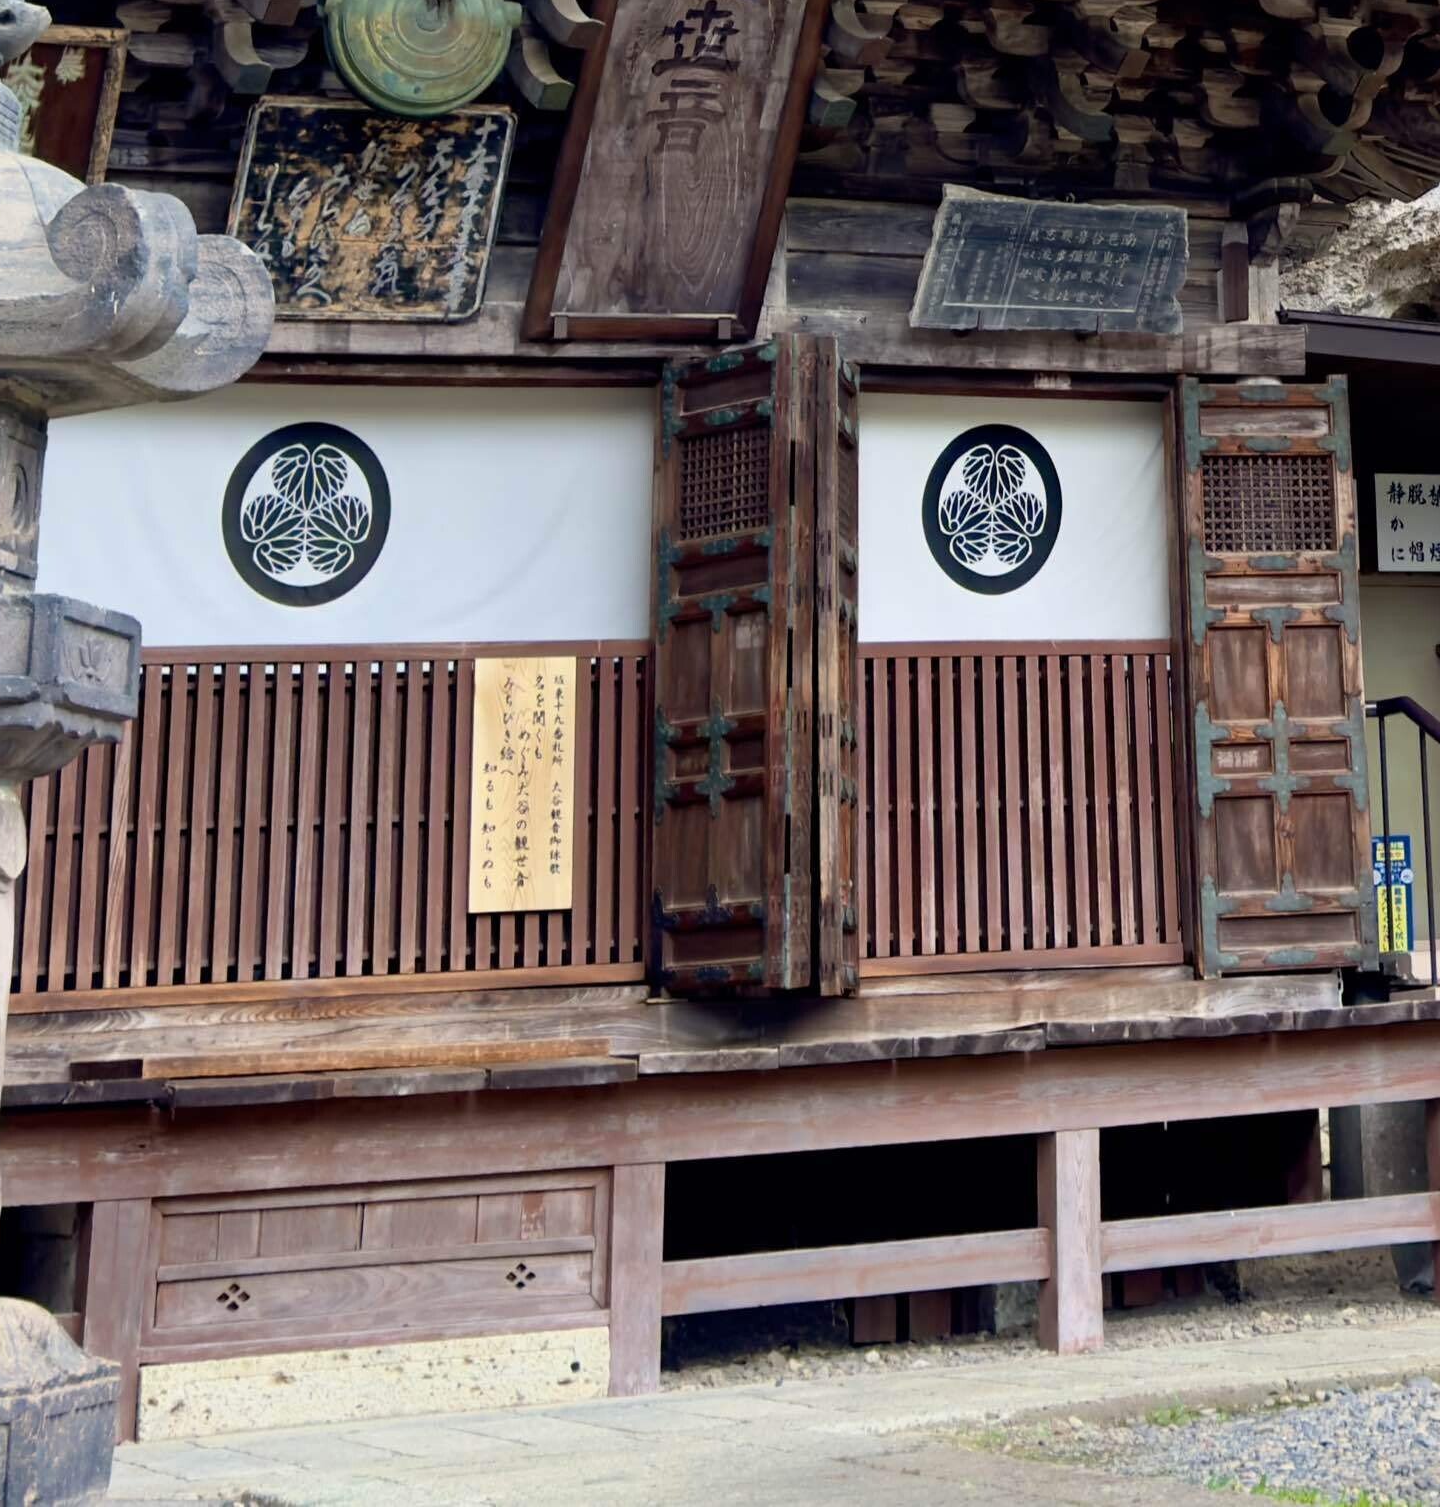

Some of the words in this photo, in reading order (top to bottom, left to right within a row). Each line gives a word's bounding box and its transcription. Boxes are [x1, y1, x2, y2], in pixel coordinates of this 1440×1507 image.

[1387, 481, 1405, 562] 静かに
[1408, 483, 1426, 562] 脱帽
[500, 677, 515, 776] みちびき給へ
[532, 675, 546, 759] 名を聞くも
[514, 730, 531, 888] めぐみ大谷の観世音
